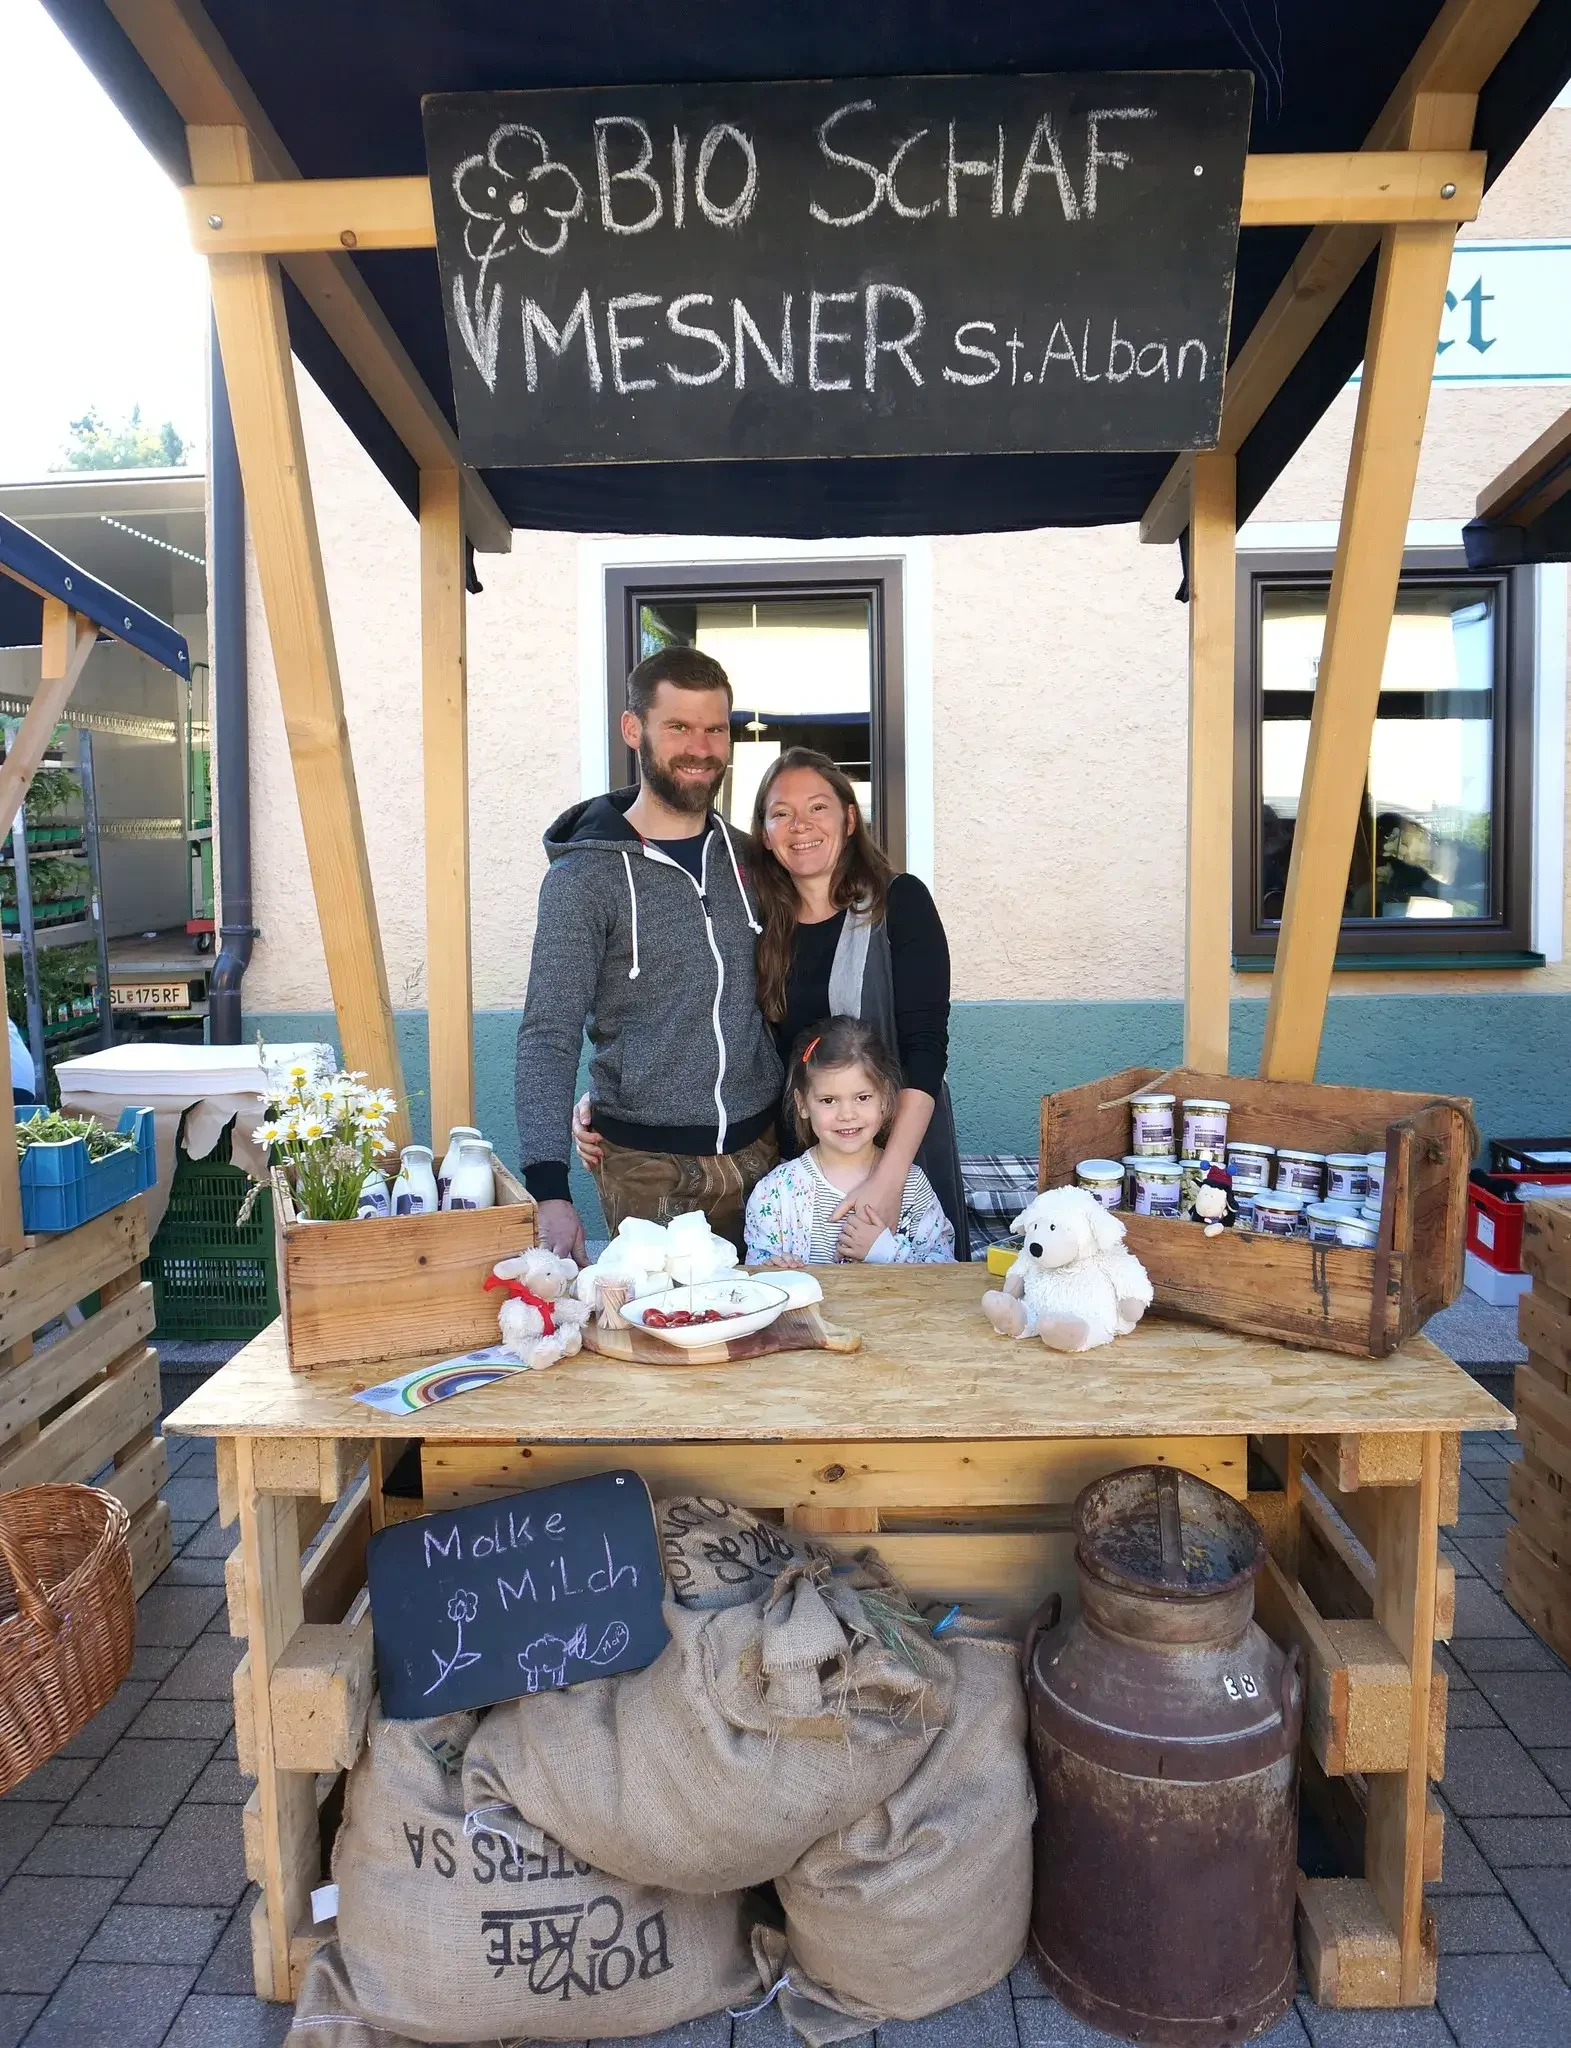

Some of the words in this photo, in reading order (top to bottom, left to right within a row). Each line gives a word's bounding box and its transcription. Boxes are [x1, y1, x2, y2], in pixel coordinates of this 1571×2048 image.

[594, 116, 758, 235] BIO
[810, 99, 1158, 227] SCHAF
[521, 284, 926, 394] MESNER
[424, 1512, 566, 1568] Molke
[403, 1821, 457, 1880] SA
